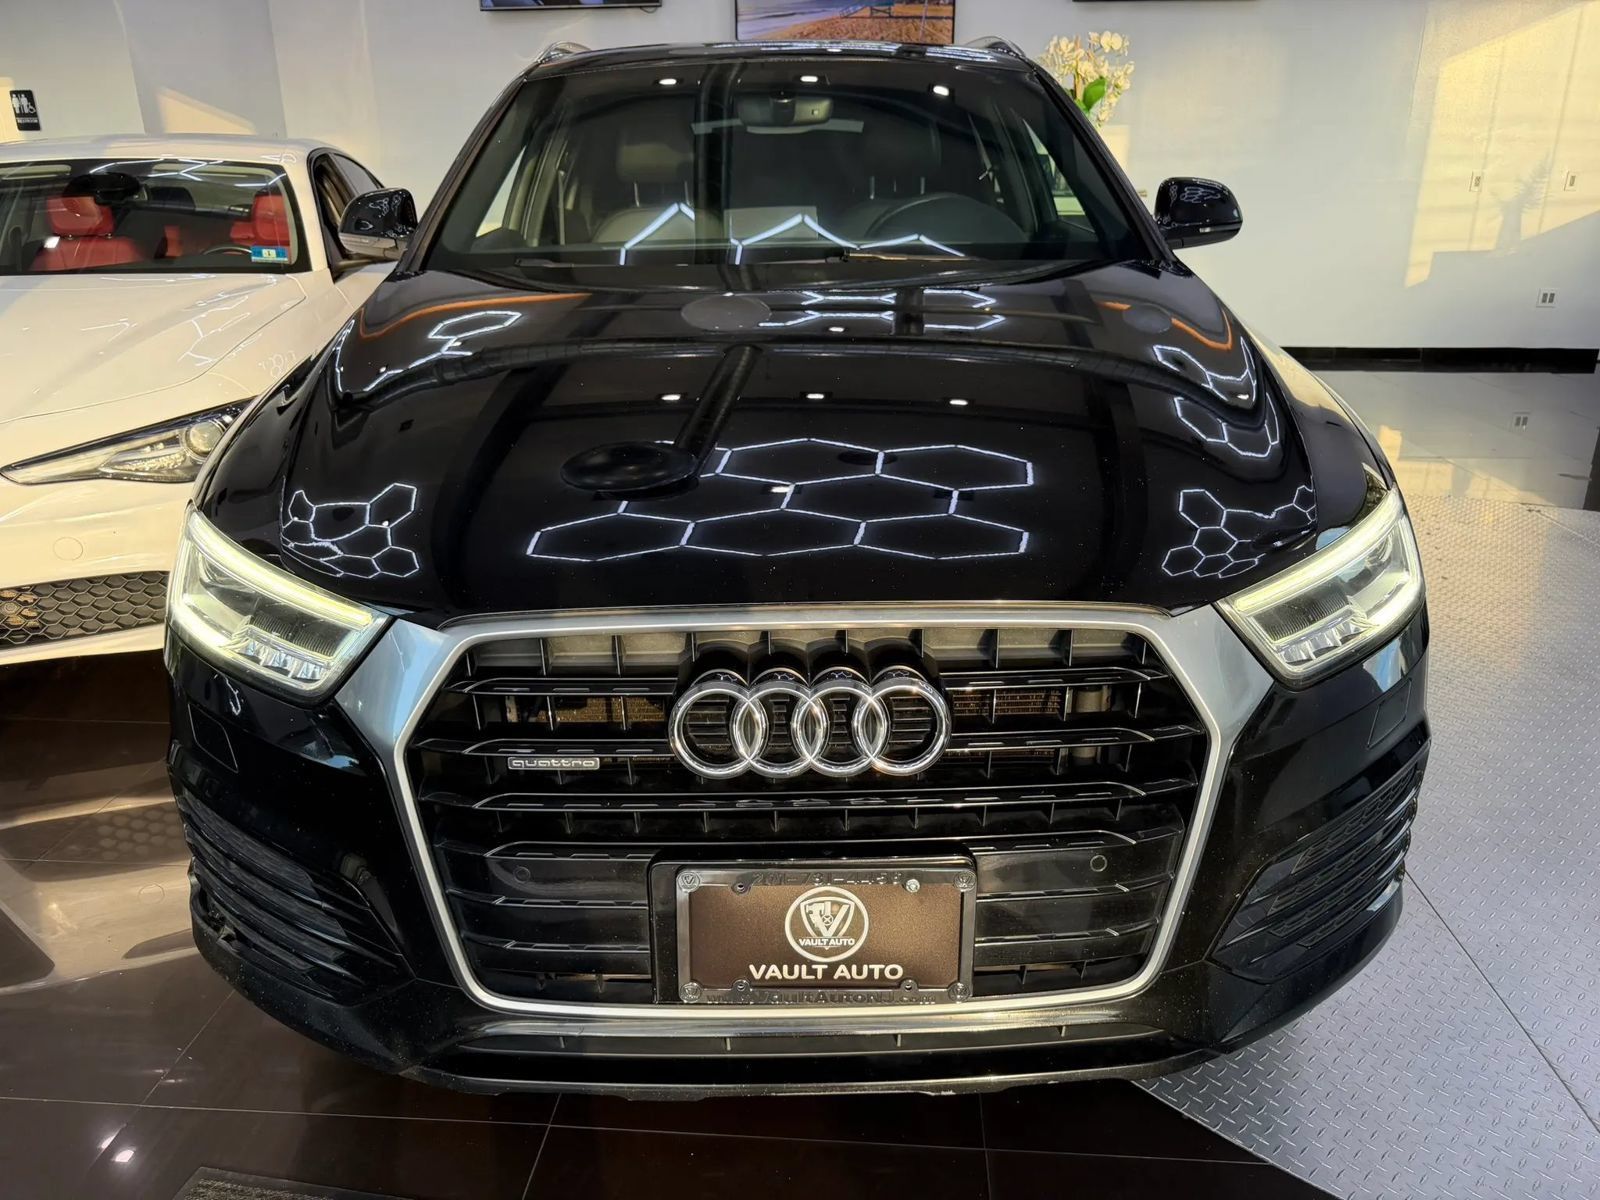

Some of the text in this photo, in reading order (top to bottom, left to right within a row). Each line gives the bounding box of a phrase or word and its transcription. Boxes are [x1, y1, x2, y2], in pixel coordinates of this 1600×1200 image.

[511, 758, 596, 768] quattro
[798, 937, 855, 946] VAULT AUTO
[749, 964, 903, 980] VAULT AUTO
